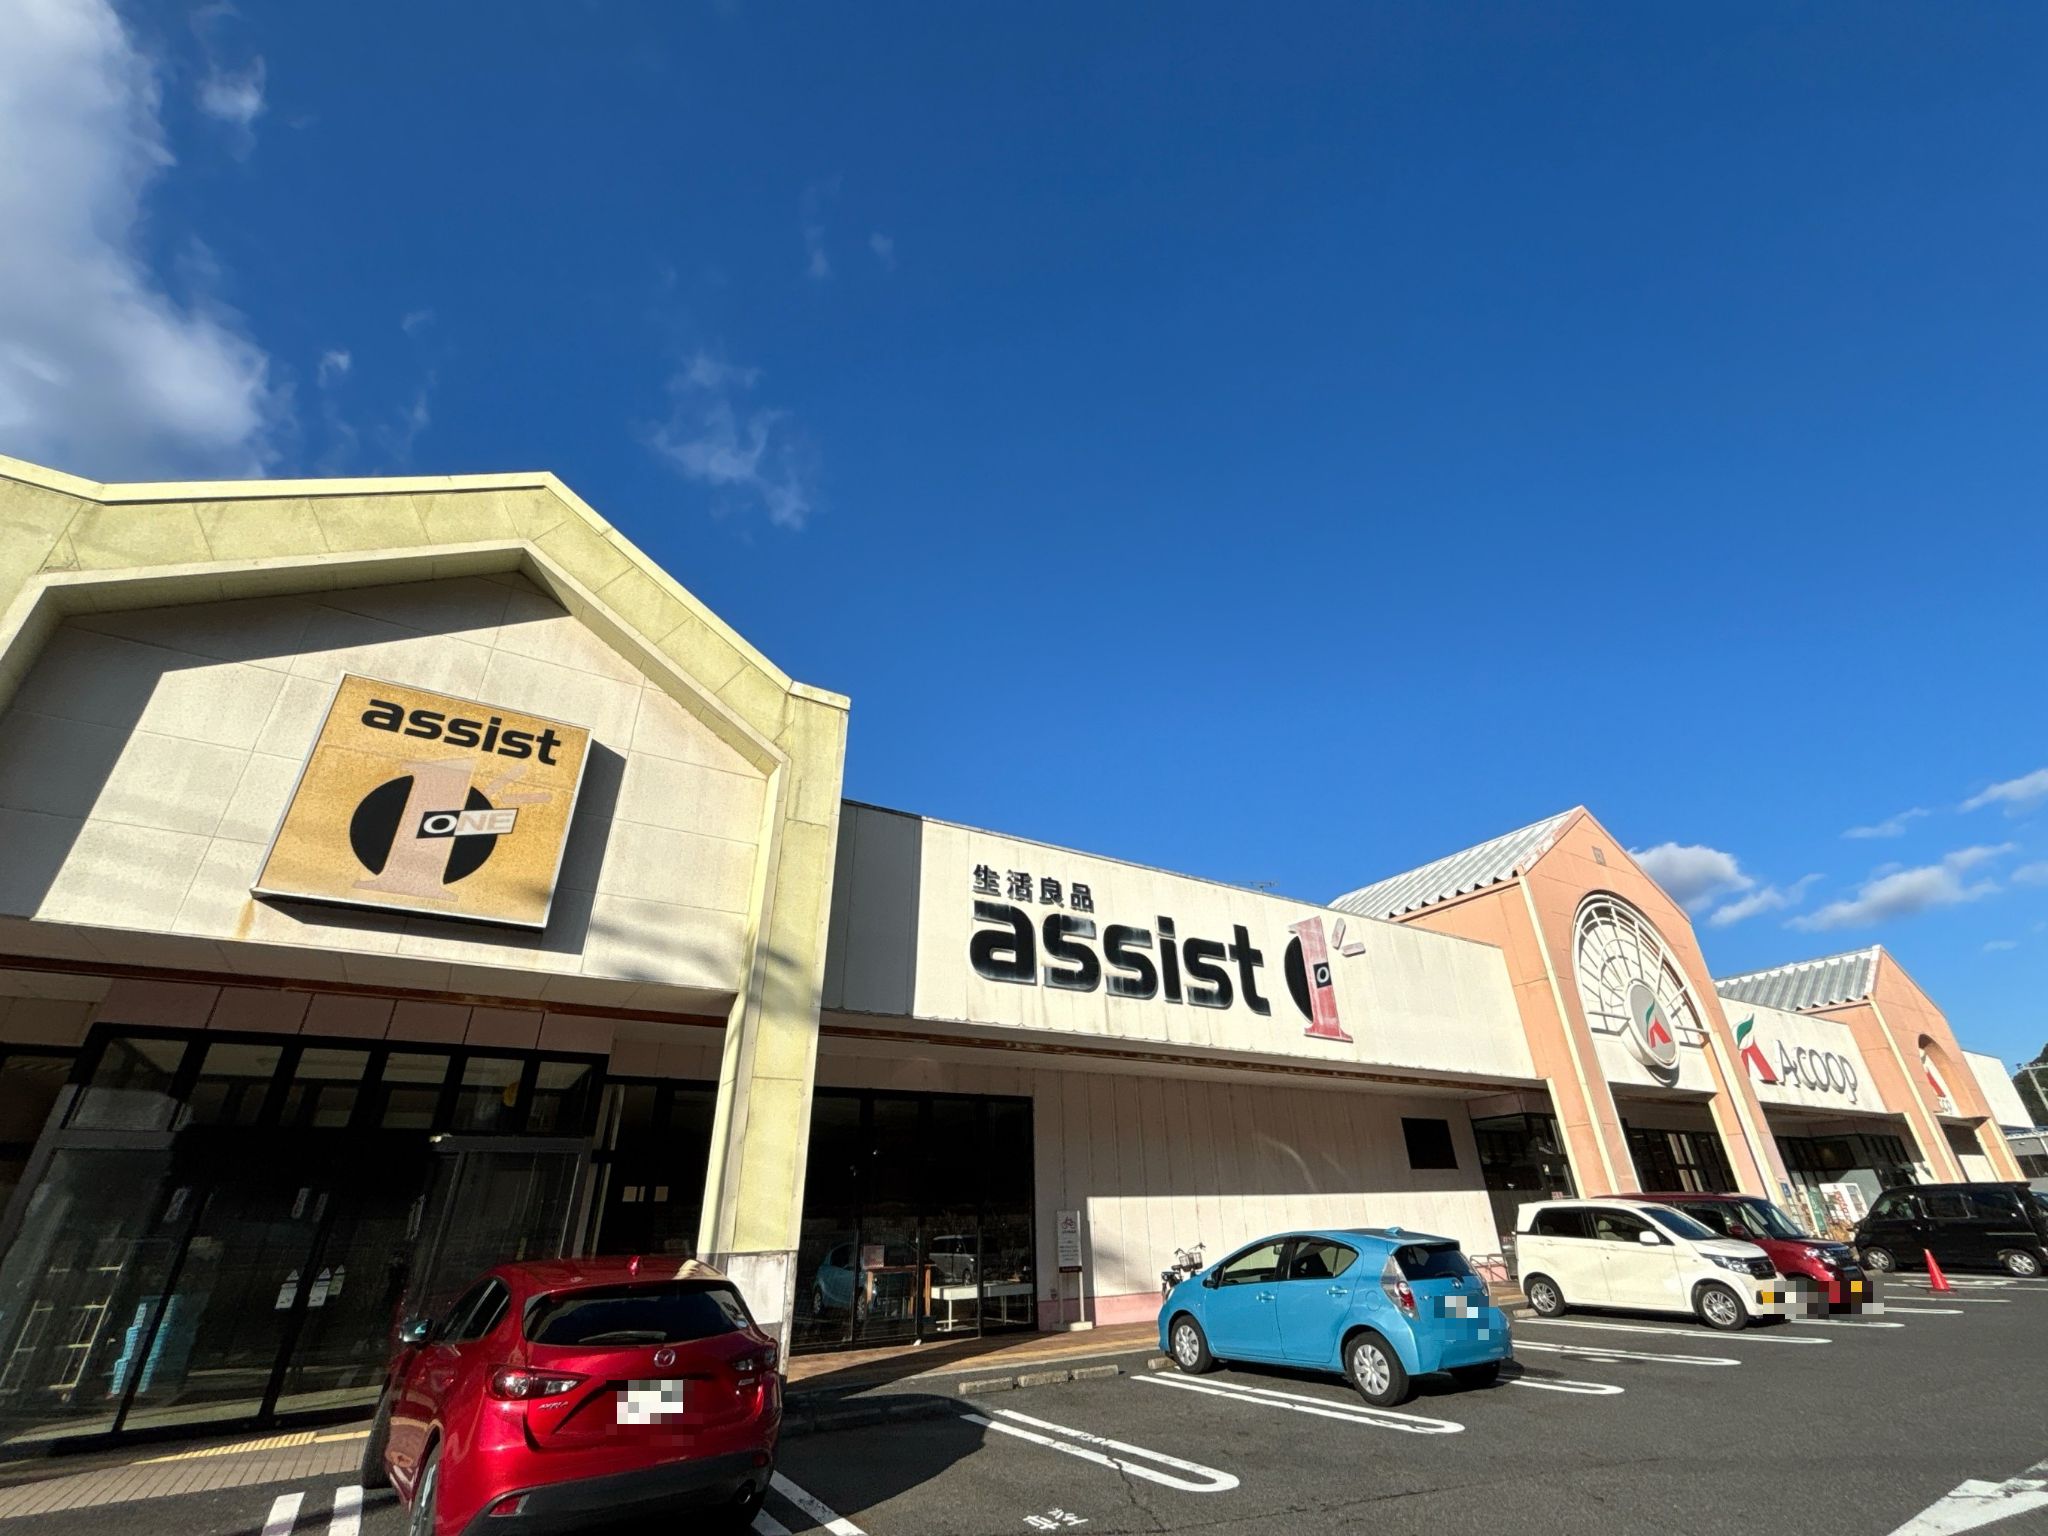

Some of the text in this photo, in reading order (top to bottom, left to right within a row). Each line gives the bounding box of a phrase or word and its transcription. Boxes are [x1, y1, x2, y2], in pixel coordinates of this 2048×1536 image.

[361, 698, 561, 766] assist
[422, 812, 514, 835] ONE
[972, 864, 1094, 913] 生活良品
[969, 900, 1271, 1016] assist
